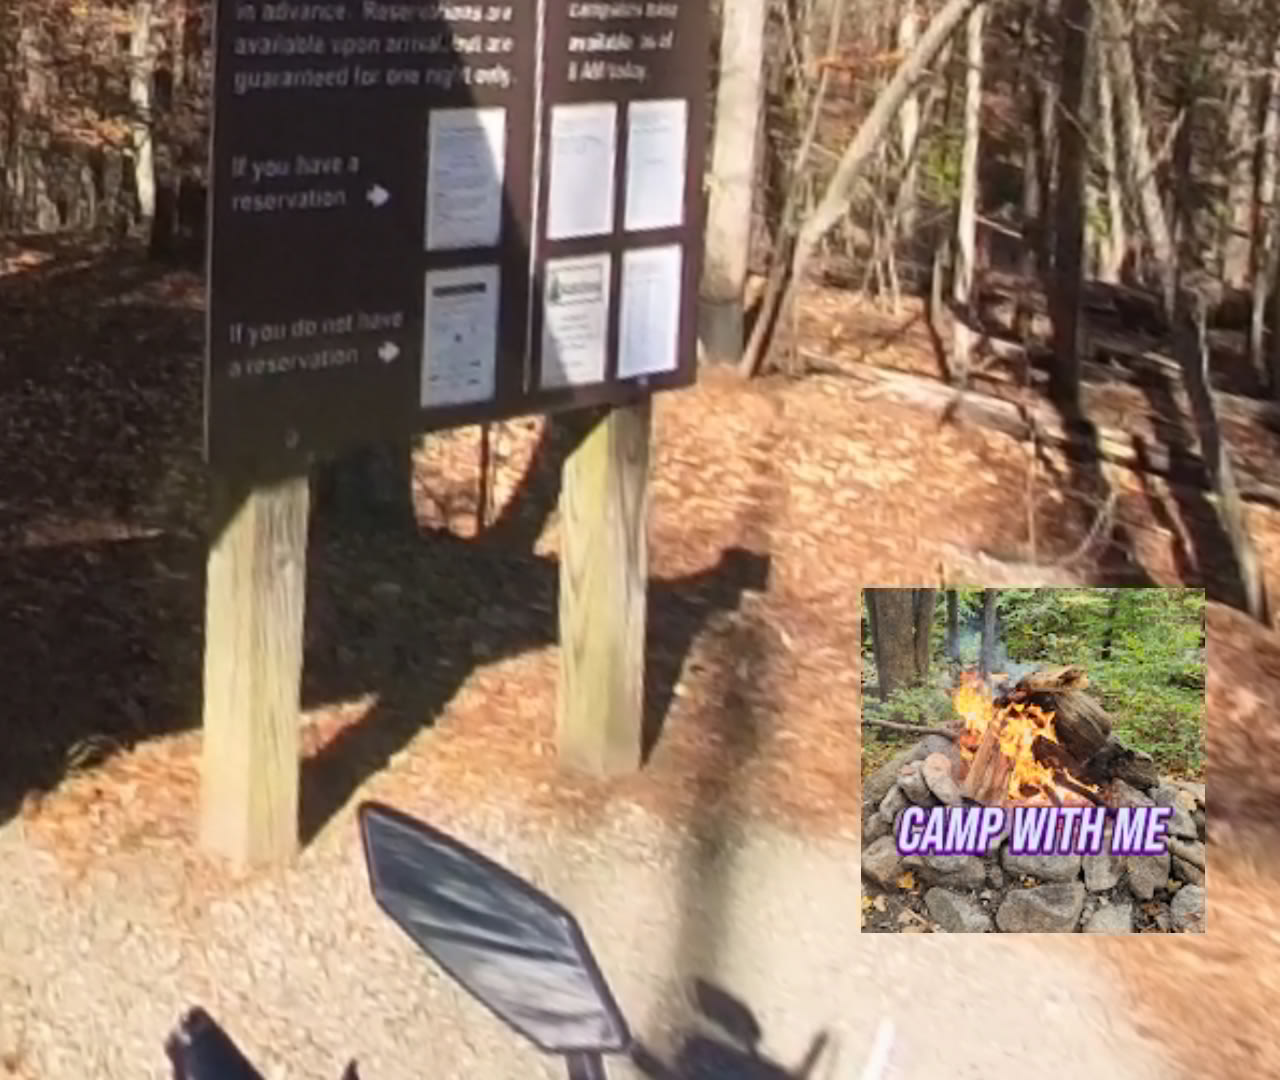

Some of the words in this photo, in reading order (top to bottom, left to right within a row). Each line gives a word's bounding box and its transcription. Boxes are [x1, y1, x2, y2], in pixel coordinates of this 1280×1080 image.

[236, 1, 256, 22] in
[362, 0, 483, 23] Reservations
[485, 4, 513, 22] are
[234, 34, 325, 55] available
[331, 37, 380, 59] upon
[451, 33, 483, 54] but
[485, 35, 515, 54] are
[233, 66, 348, 95] guaranteed
[354, 64, 379, 87] for
[385, 67, 421, 86] one
[424, 65, 472, 91] nigt
[231, 154, 248, 178] If
[251, 158, 290, 183] you
[295, 153, 344, 176] have
[346, 155, 360, 174] a
[231, 189, 346, 212] reservation
[229, 322, 243, 345] If
[246, 323, 287, 349] you
[290, 318, 318, 338] do
[322, 313, 354, 335] not
[357, 309, 405, 331] have
[226, 360, 242, 379] a
[245, 348, 358, 375] reservation
